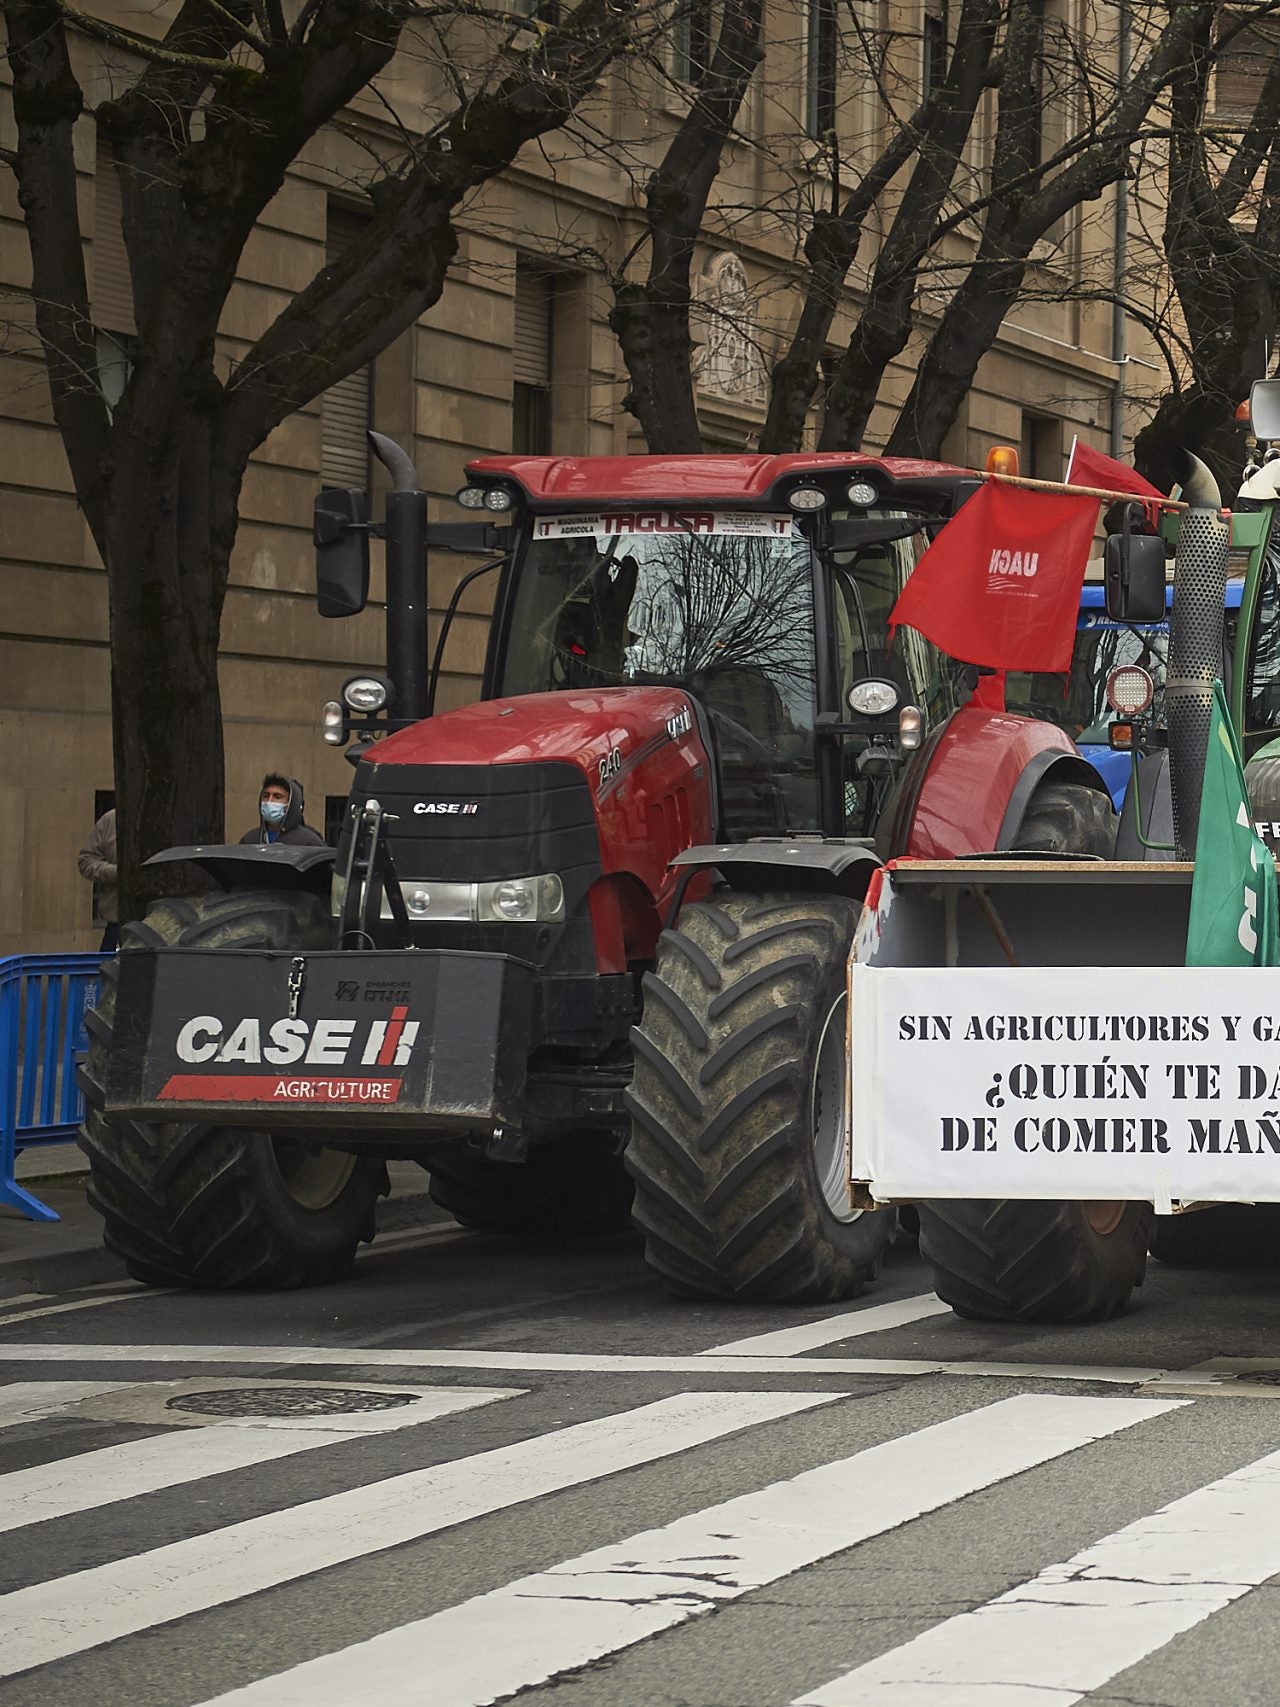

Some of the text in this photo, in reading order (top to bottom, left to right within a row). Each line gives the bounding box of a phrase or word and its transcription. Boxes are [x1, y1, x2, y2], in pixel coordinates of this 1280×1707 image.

[600, 511, 716, 534] TAGUSA
[599, 746, 621, 786] 240
[413, 802, 461, 814] CASE
[176, 1015, 357, 1065] CASE
[899, 1015, 953, 1041] SIN
[963, 1015, 1209, 1042] AGRICULTORES
[1220, 1016, 1242, 1041] Y
[985, 1055, 1150, 1109] ¿QUIÉN
[1166, 1064, 1220, 1100] TE
[940, 1117, 997, 1152] DE
[1014, 1117, 1171, 1154] COMER
